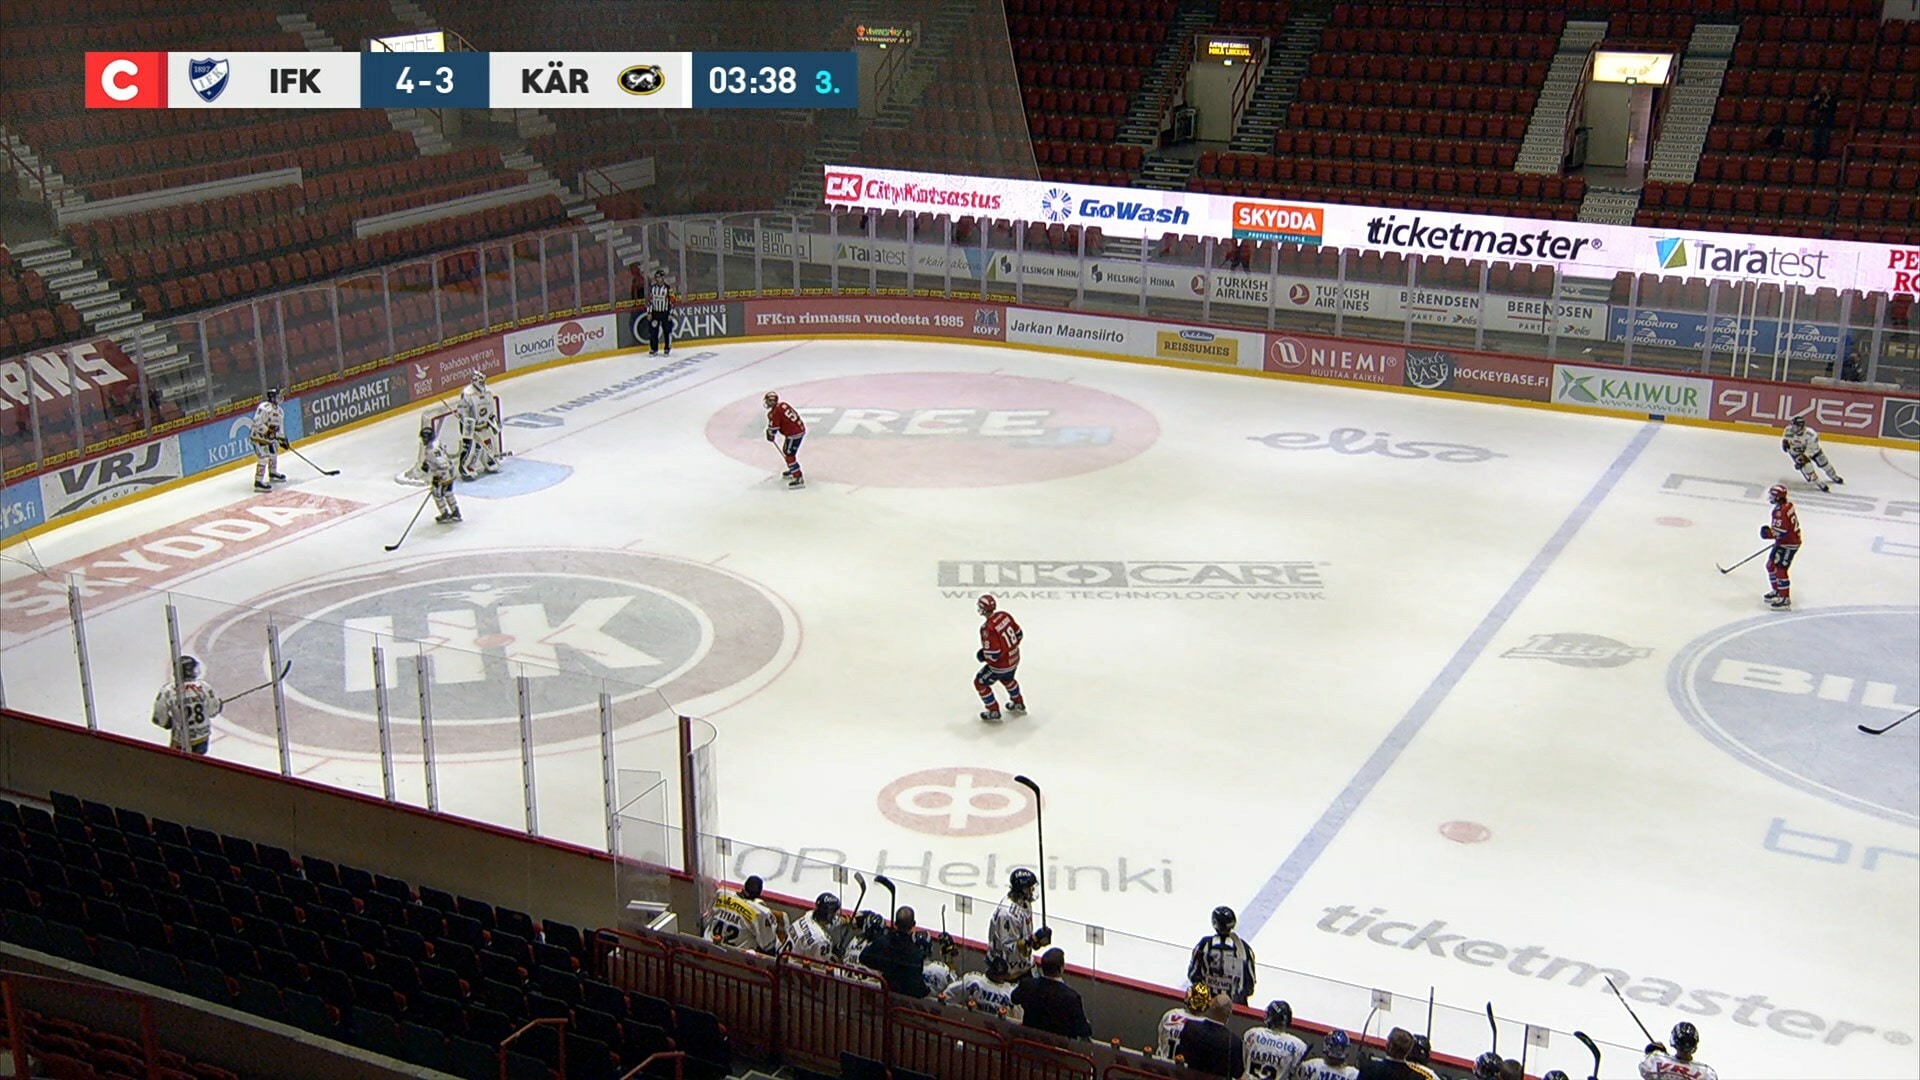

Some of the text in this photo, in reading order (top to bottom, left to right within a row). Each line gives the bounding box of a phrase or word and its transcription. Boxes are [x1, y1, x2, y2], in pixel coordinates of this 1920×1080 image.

[1079, 198, 1190, 226] GoWash
[1239, 207, 1317, 231] SKYDDA
[1367, 215, 1590, 261] ticketmaster
[1018, 264, 1055, 277] ELSINGIN
[1698, 243, 1830, 280] Taratest
[1215, 287, 1269, 302] AIRLINES
[1216, 276, 1269, 291] TURKISH
[670, 304, 727, 317] AKENNUS
[1315, 297, 1370, 312] AIRINES
[756, 313, 965, 329] IFK:n rinnassa vuodesta 1985
[973, 325, 1000, 337] KOFF
[1010, 319, 1125, 344] Jarkan Maansiirto
[514, 335, 555, 356] Lounari
[557, 326, 605, 347] Edenred
[1164, 341, 1230, 357] REISSUMIES
[1310, 348, 1385, 373] NIEMI
[1310, 367, 1385, 383] MUUTTAA KAIKEN
[1453, 366, 1549, 388] HOCKEYBASE.FI
[311, 378, 390, 415] CITYMARKET
[1600, 378, 1698, 408] KAIWUR
[314, 394, 391, 430] RUOHOLAHTI
[1245, 427, 1509, 463] elisa
[59, 442, 162, 496] VRJ
[90, 486, 140, 505] GROUP
[0, 504, 326, 617] SKYDDA
[940, 590, 1326, 601] WE MAKE TECHNOLOGY WORK
[1002, 625, 1018, 649] 18
[712, 919, 740, 947] 42
[1316, 904, 1876, 1047] ticketmaster
